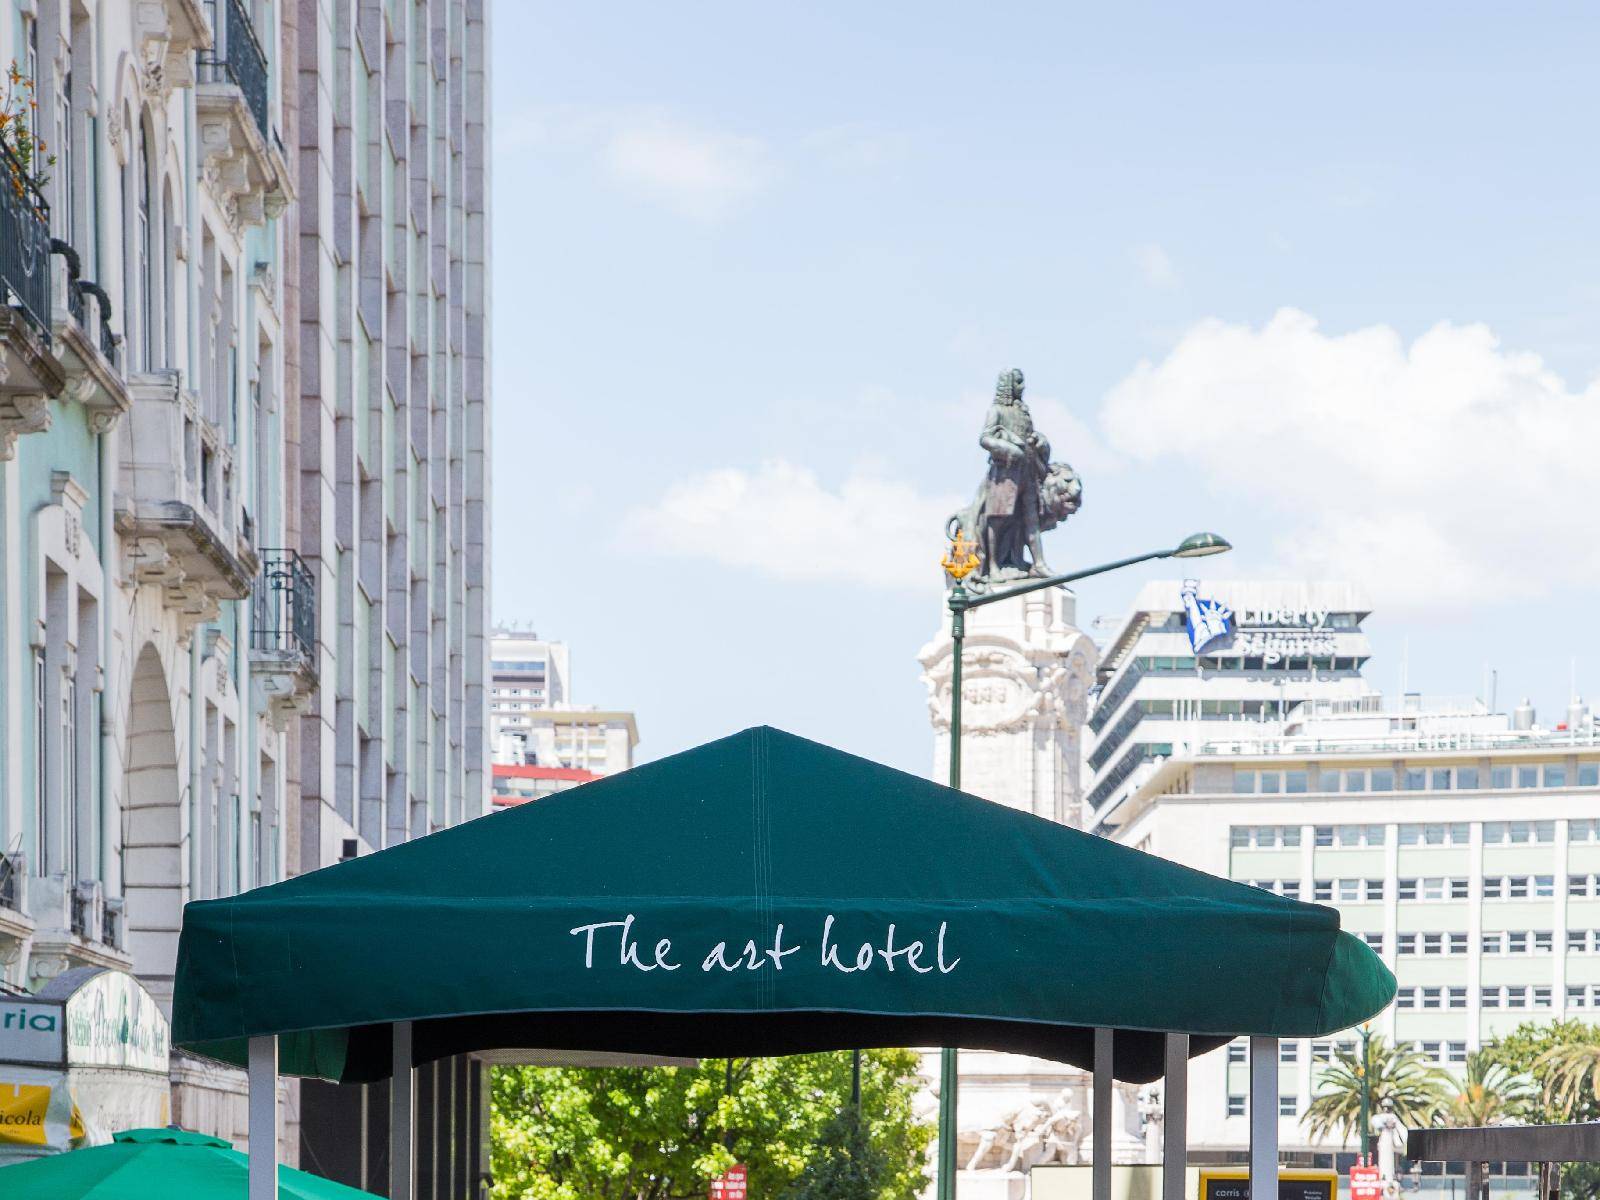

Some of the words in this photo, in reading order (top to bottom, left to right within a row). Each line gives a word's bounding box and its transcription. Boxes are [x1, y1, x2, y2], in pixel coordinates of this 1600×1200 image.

[1235, 605, 1328, 632] Liberty
[1234, 636, 1337, 664] Seguros
[569, 914, 681, 972] The
[701, 923, 800, 972] art
[821, 914, 961, 974] hotel
[4, 1008, 56, 1032] ria
